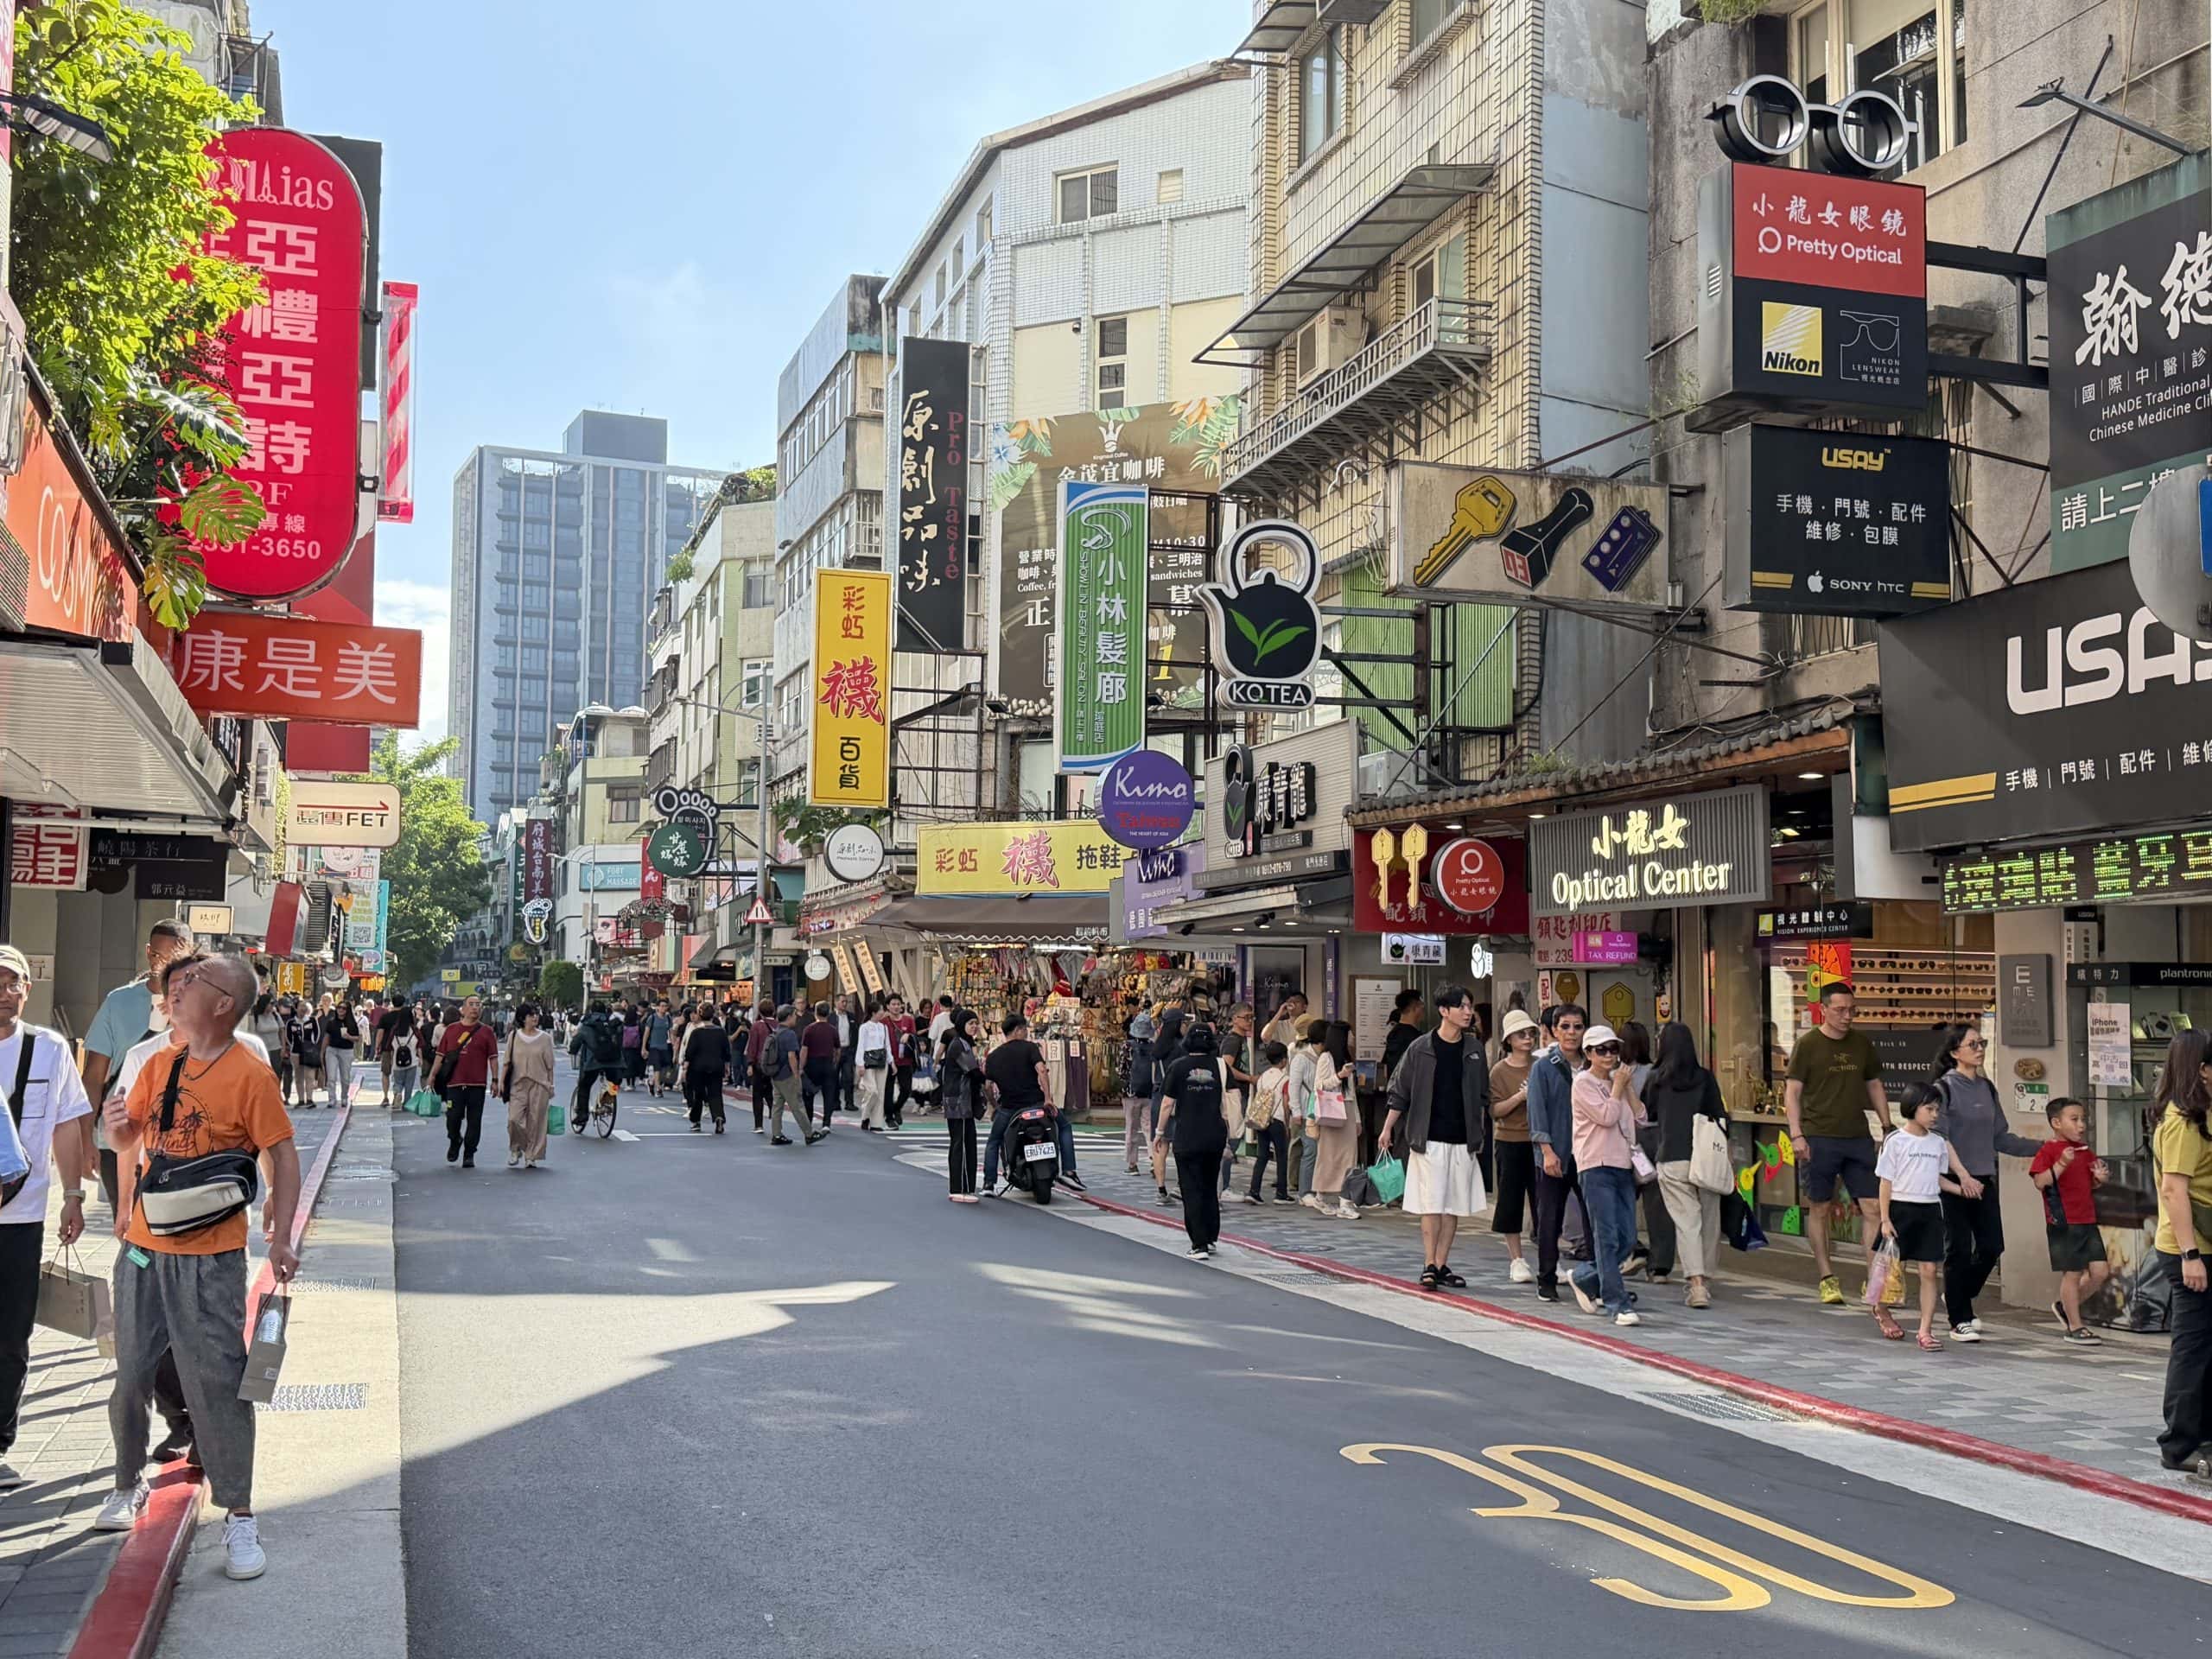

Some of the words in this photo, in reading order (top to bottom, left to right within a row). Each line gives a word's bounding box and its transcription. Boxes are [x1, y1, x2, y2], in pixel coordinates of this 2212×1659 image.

[1752, 193, 1907, 237] 小龍女眼鏡
[1787, 234, 1838, 259] Pretty
[1840, 242, 1903, 264] Optical
[237, 219, 319, 474] 亞禮亞詩
[1764, 351, 1821, 373] Nikon
[1872, 357, 1900, 365] NIKON
[1852, 364, 1900, 374] LENSWEAR
[2101, 393, 2143, 421] HANDE
[2145, 373, 2211, 406] Traditional
[946, 410, 963, 467] Pro
[2088, 418, 2134, 442] Chinese
[2138, 399, 2191, 429] Medicine
[1057, 456, 1166, 483] 金茂宜咖啡
[1821, 447, 1885, 472] USAY
[899, 389, 940, 593] 原創品味
[1776, 493, 1814, 516] 手機
[1834, 498, 1871, 519] 門號
[1891, 502, 1928, 524] 配件
[944, 486, 962, 581] Taste
[1805, 520, 1842, 541] 維修
[1864, 524, 1899, 545] 包膜
[1150, 570, 1204, 582] sandwiches
[1830, 579, 1872, 592] SONY
[842, 586, 866, 639] 彩虹
[1024, 595, 1051, 627] 正
[1096, 551, 1129, 705] 小林髮廊
[179, 629, 398, 704] 康是美
[2006, 605, 2212, 715] USA
[1232, 683, 1307, 704] KOTEA
[839, 736, 861, 790] 百貨
[2005, 767, 2039, 792] 手機
[2061, 759, 2095, 785] 門號
[2120, 749, 2156, 775] 配件
[1115, 766, 1188, 798] Kimo
[346, 812, 388, 827] FET
[1592, 804, 1690, 860] 小龍女
[531, 822, 546, 903] 府城台南美
[935, 847, 978, 873] 彩虹
[1076, 843, 1122, 870] 拖鞋
[151, 882, 187, 896] 郭元益
[1552, 863, 1639, 911] Optical
[1643, 860, 1733, 896] Center
[1713, 1141, 1726, 1154] Mr.
[1339, 1442, 1955, 1611] 30
